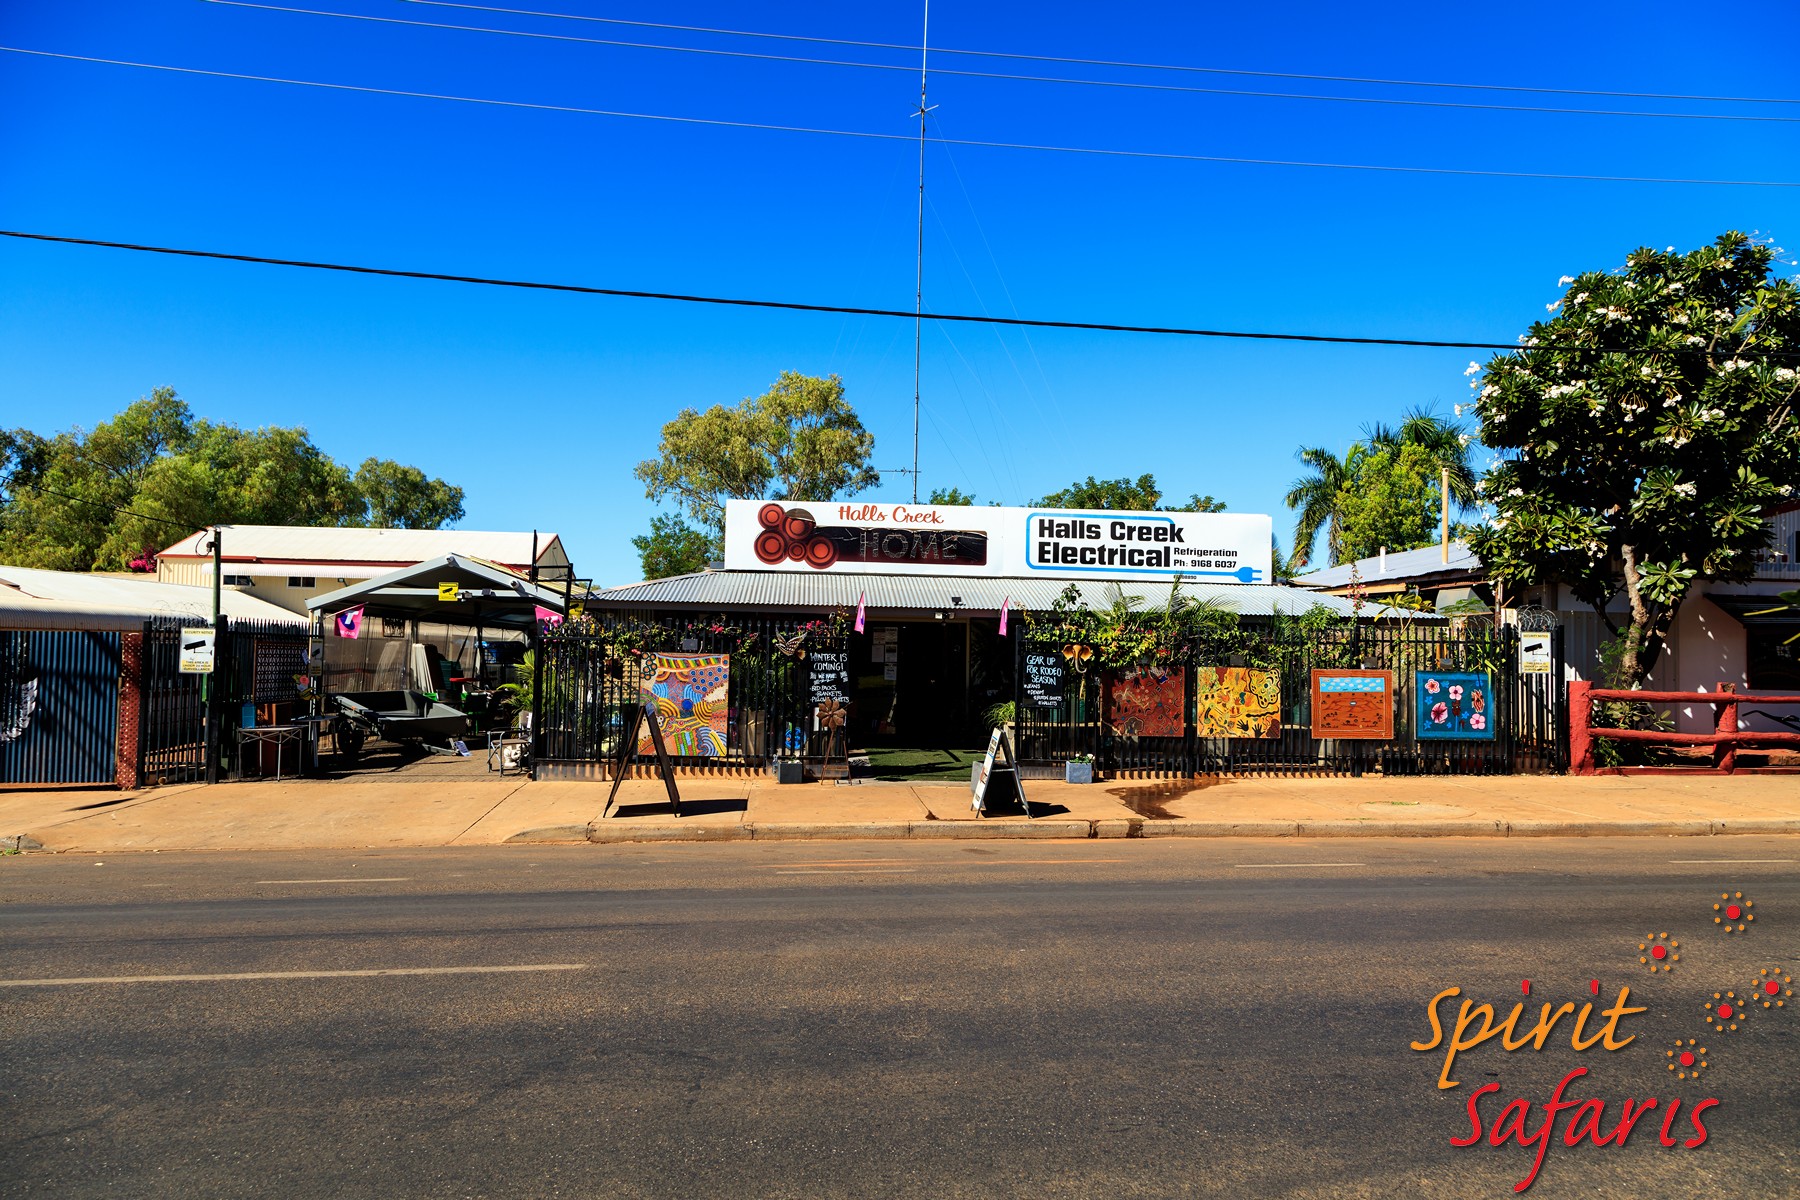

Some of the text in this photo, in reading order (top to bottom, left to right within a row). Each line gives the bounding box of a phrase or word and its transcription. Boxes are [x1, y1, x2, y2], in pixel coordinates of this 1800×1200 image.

[838, 505, 944, 524] Halls Creek
[1038, 519, 1185, 543] Halls Creek
[859, 531, 957, 560] HOME
[1037, 542, 1171, 567] Electrical
[1173, 547, 1238, 557] Refrigeration
[1173, 559, 1189, 567] Ph:
[810, 652, 847, 662] WINTER IS
[1026, 655, 1055, 665] GEAR UP
[814, 662, 843, 671] COMING!
[1026, 665, 1062, 677] FOR RODEO
[1031, 674, 1056, 685] SEASON
